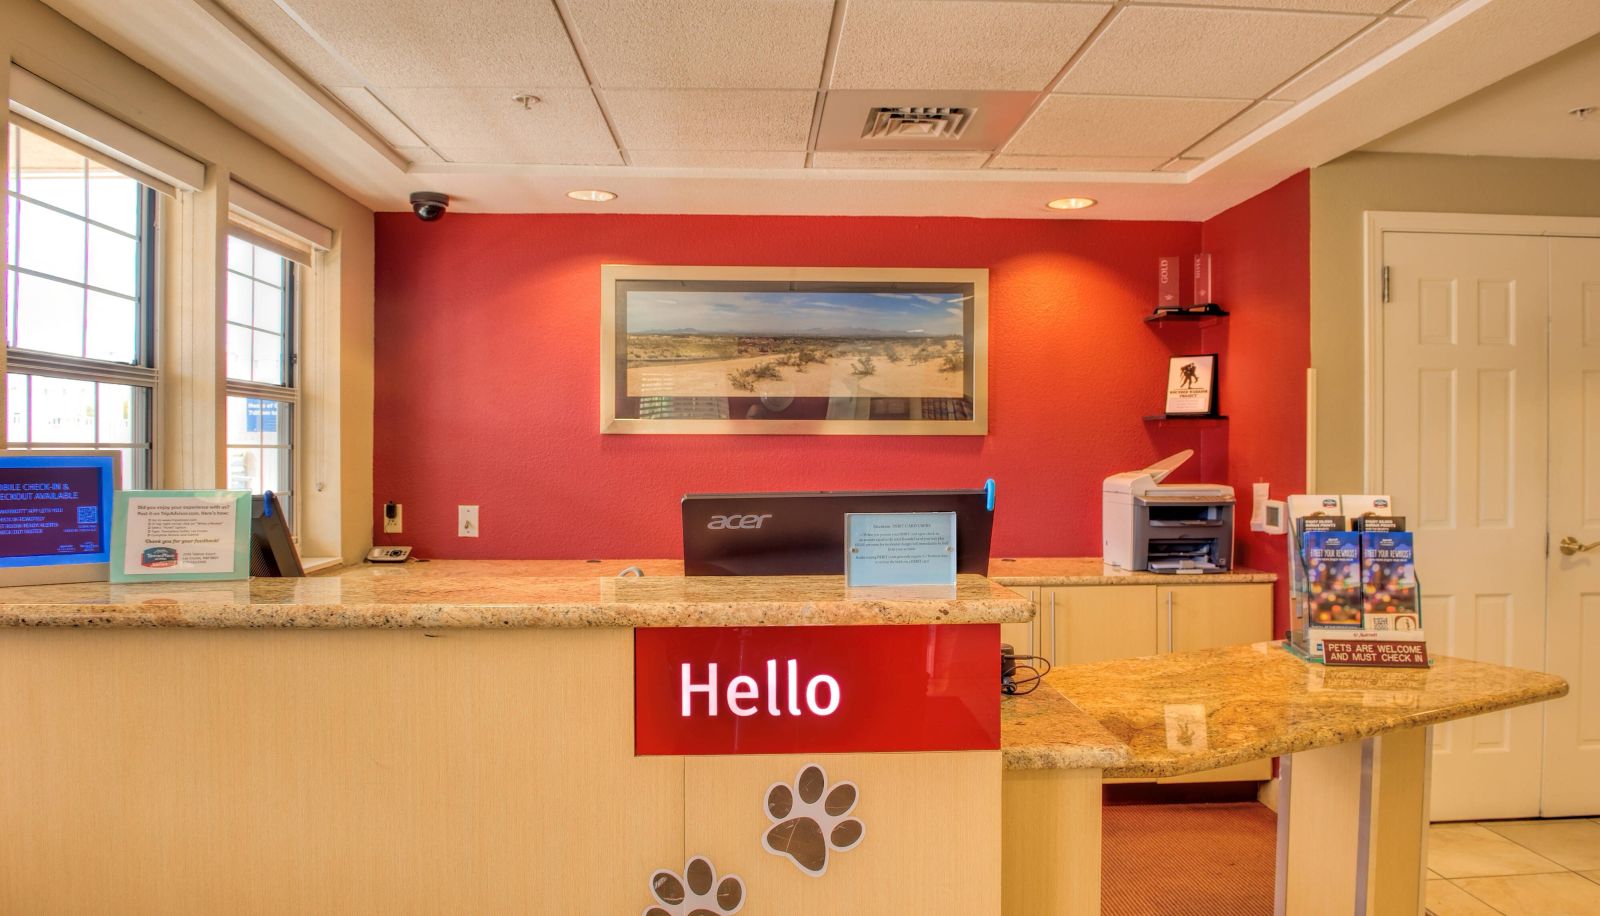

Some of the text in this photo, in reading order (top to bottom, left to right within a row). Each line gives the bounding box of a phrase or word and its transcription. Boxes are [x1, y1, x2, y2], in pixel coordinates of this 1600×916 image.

[1160, 259, 1169, 284] GOLD
[34, 492, 79, 500] AVAILABLE
[707, 514, 772, 530] acer
[1328, 644, 1352, 652] PETS
[1355, 644, 1374, 652] ARE
[1377, 644, 1423, 654] WELCOME
[1352, 653, 1377, 661] MUST
[1381, 654, 1411, 662] CHECK
[1414, 654, 1423, 662] IN
[680, 658, 841, 717] Hello
